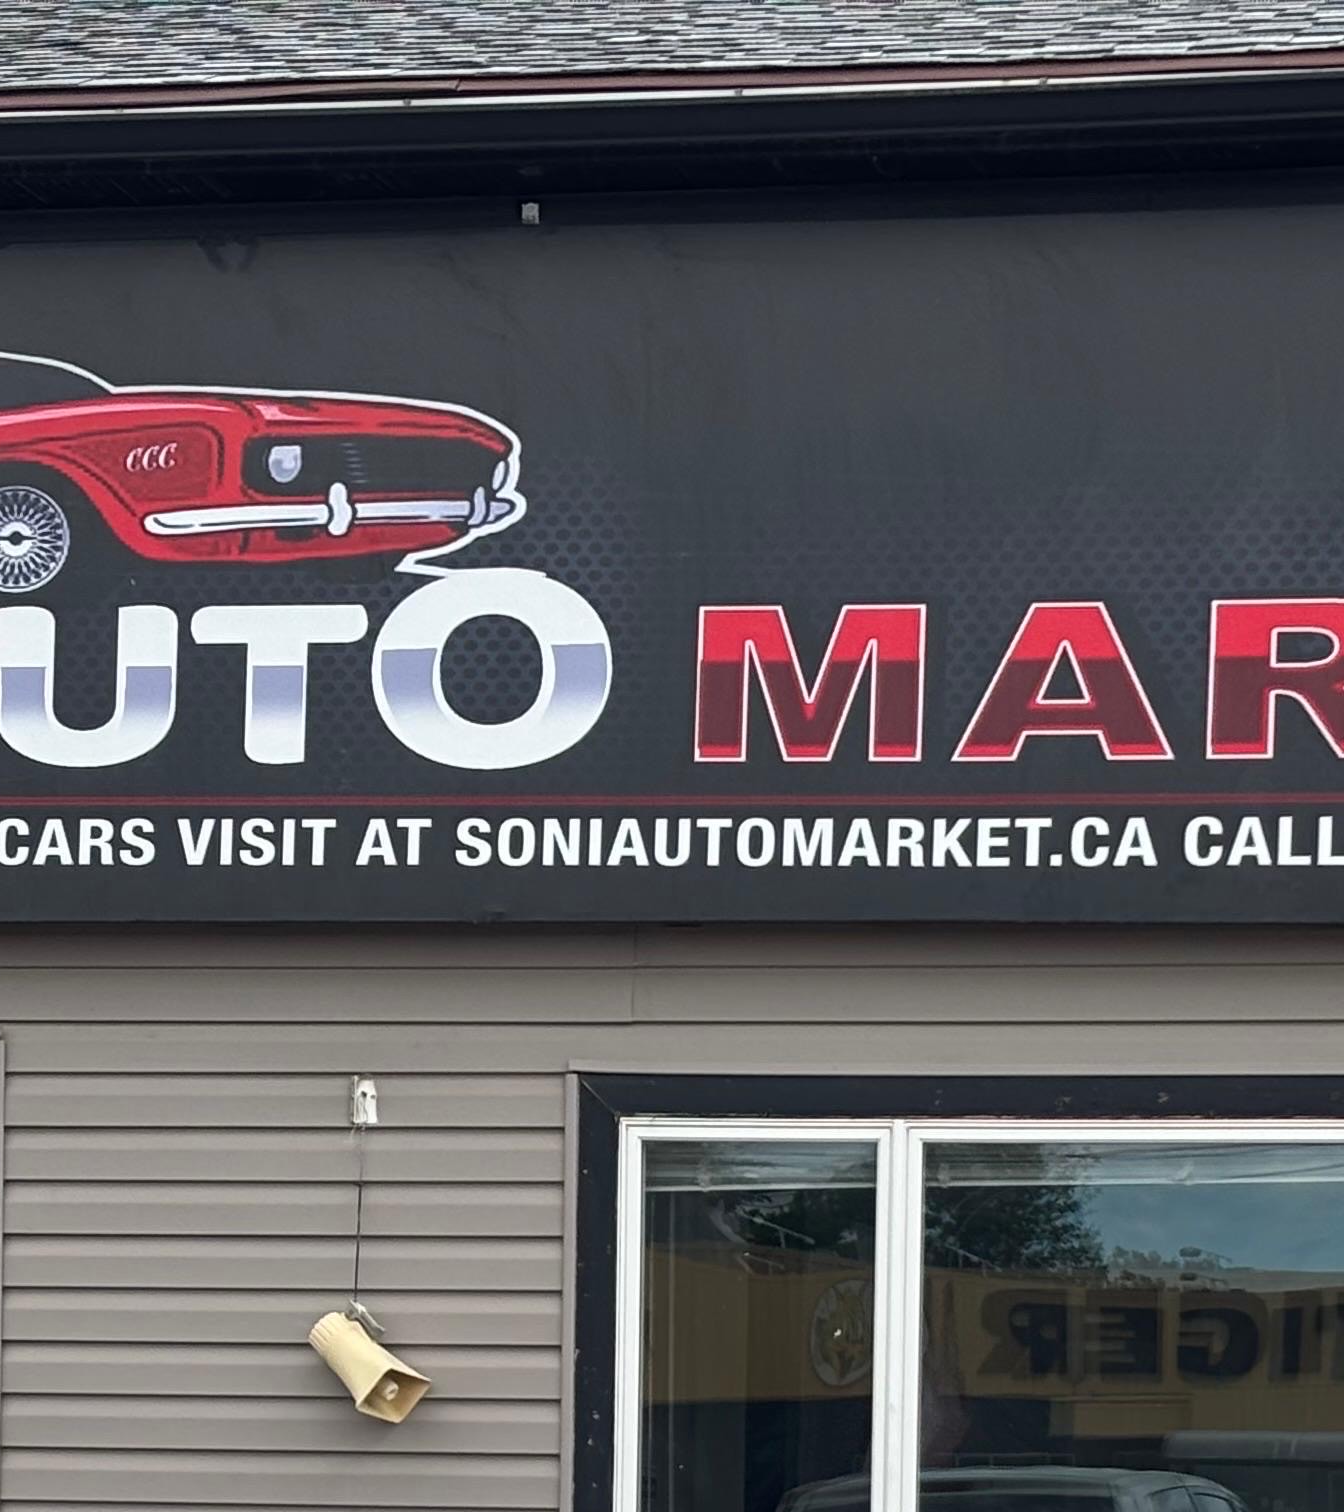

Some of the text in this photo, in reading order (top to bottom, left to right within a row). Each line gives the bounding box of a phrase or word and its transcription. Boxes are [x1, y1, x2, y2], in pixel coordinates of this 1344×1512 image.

[177, 817, 337, 866] VISIT
[355, 818, 433, 866] AT
[455, 815, 1158, 867] SONIAUTOMARKET.CA
